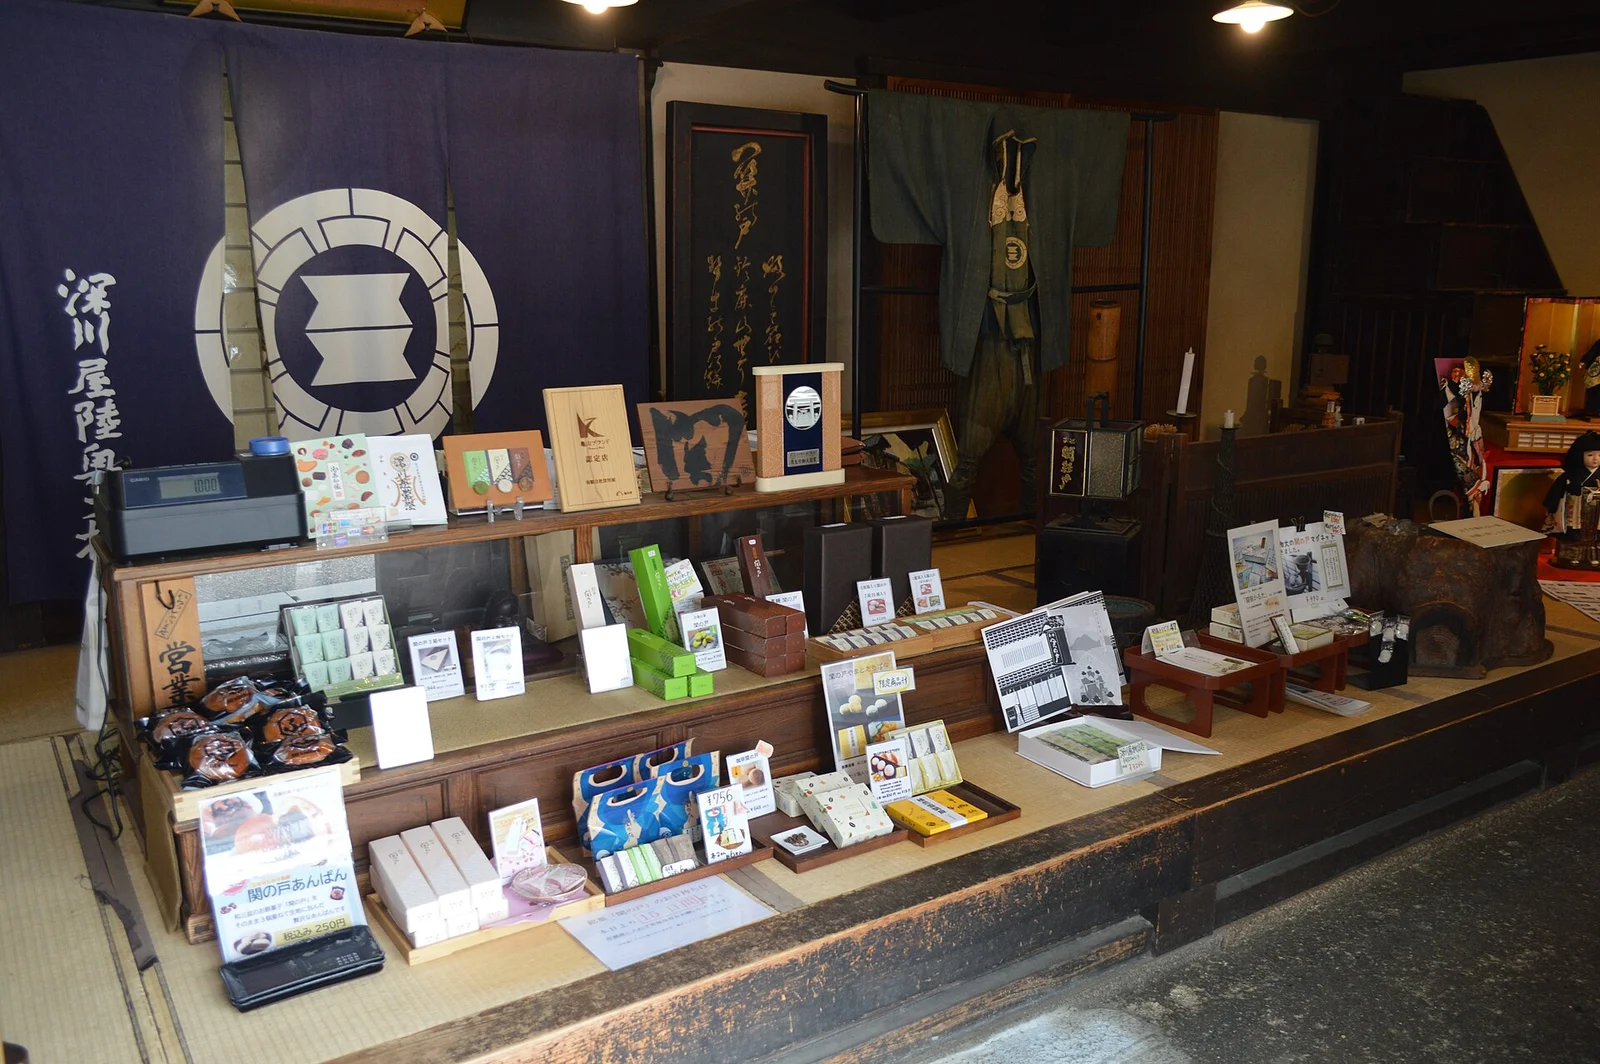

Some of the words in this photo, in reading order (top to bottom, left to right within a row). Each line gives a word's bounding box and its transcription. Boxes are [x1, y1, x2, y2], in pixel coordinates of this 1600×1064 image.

[707, 789, 733, 806] ¥756
[247, 868, 348, 902] 関の戸あんぱん
[315, 917, 347, 934] 250円
